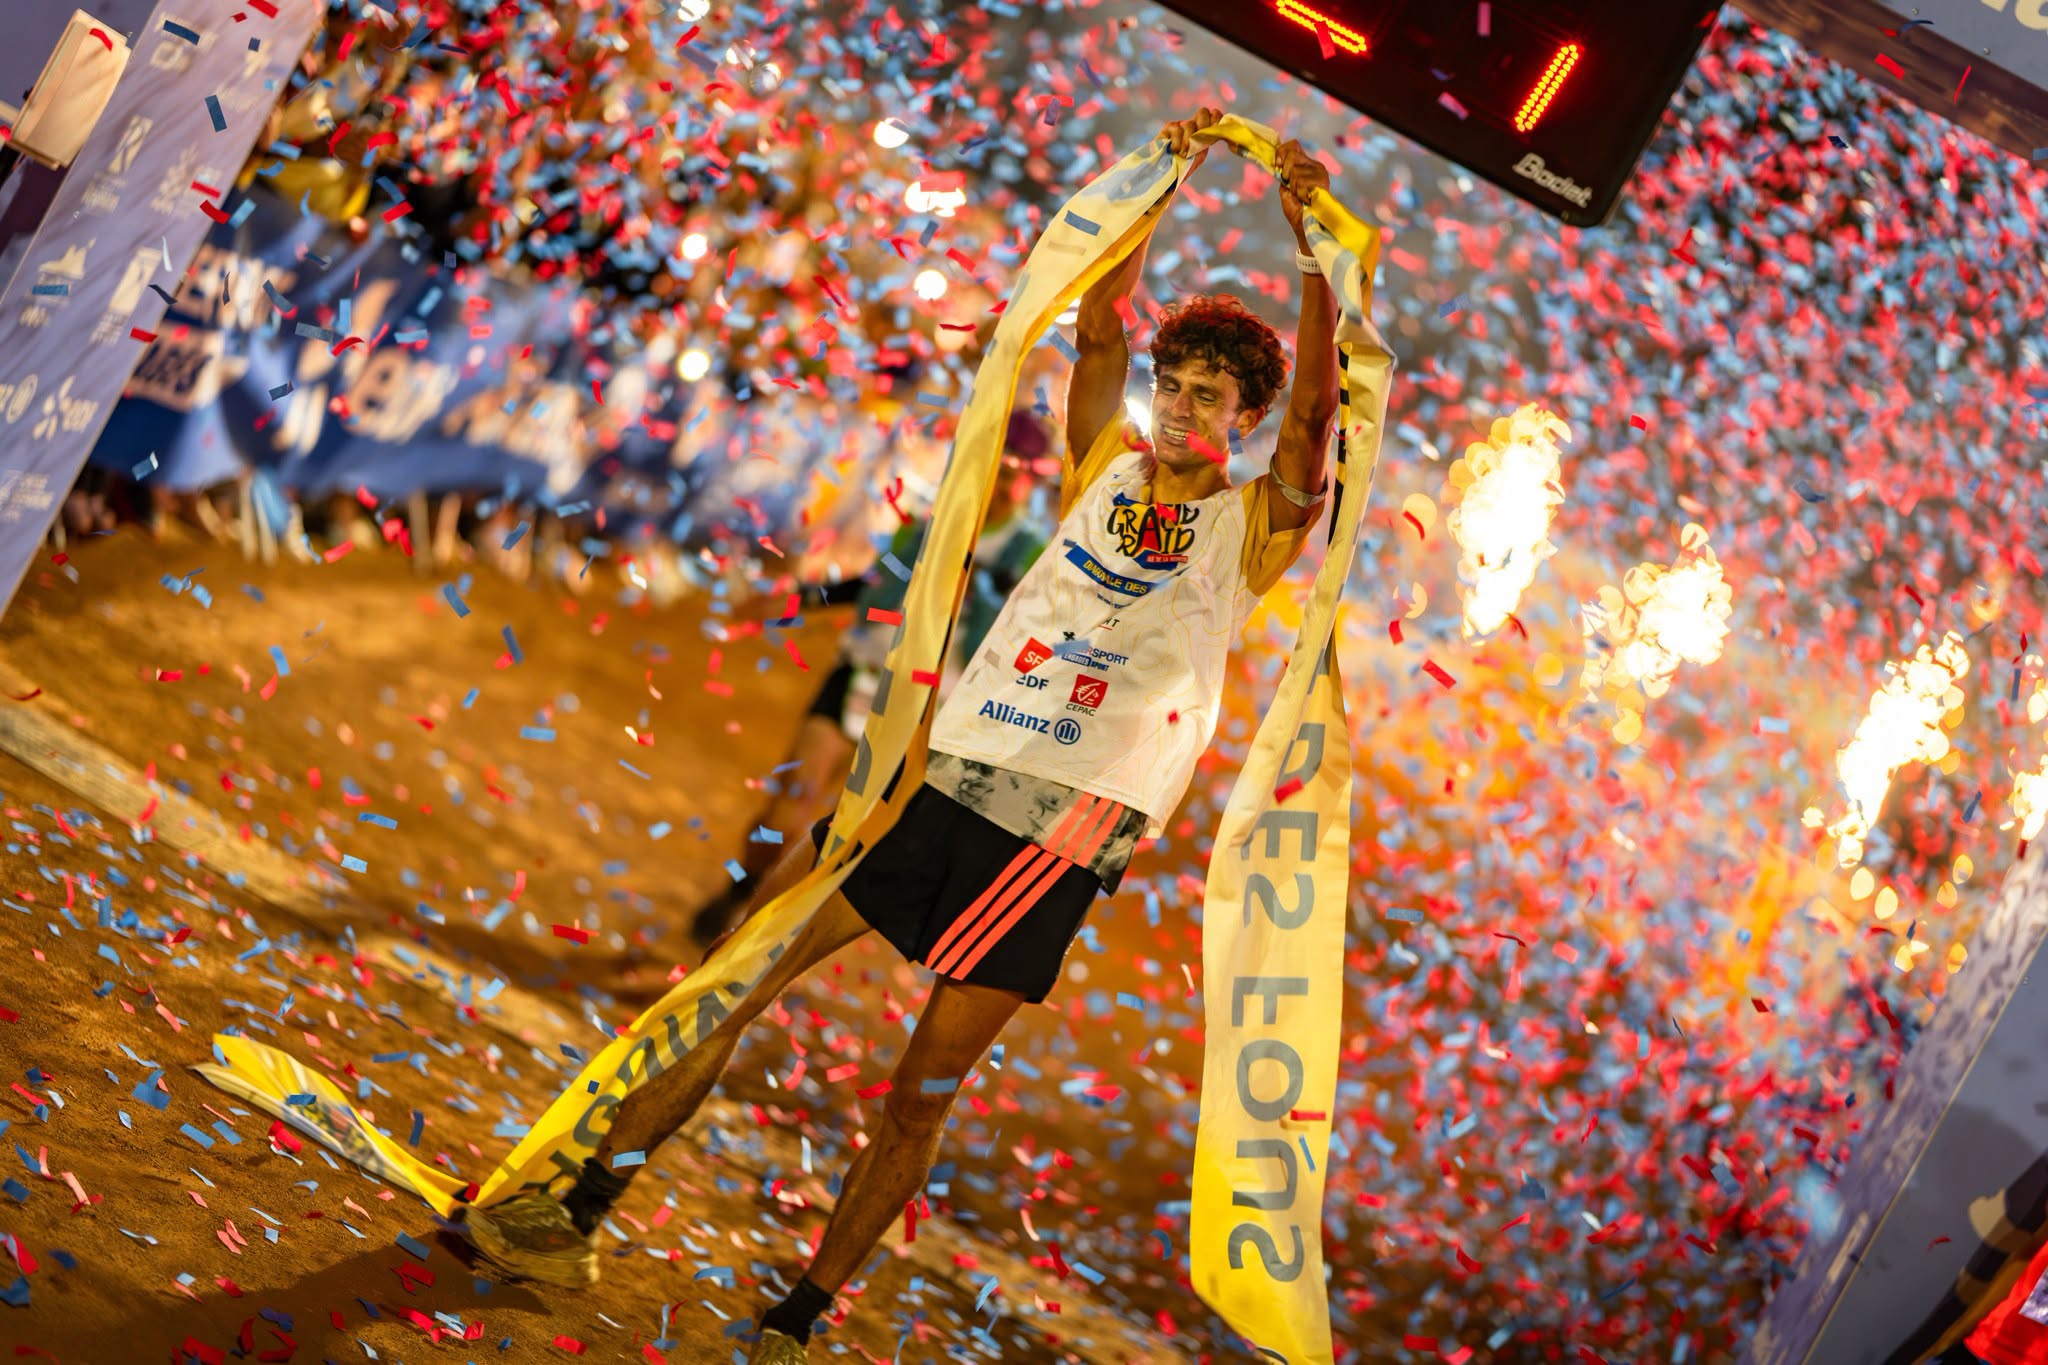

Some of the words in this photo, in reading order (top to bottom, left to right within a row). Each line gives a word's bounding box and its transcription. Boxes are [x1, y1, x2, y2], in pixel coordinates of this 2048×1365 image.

[1512, 152, 1593, 208] Bodet
[1124, 581, 1148, 594] DES
[1024, 651, 1046, 666] SF
[978, 699, 1051, 734] Allianz
[1065, 703, 1097, 717] CEPAC
